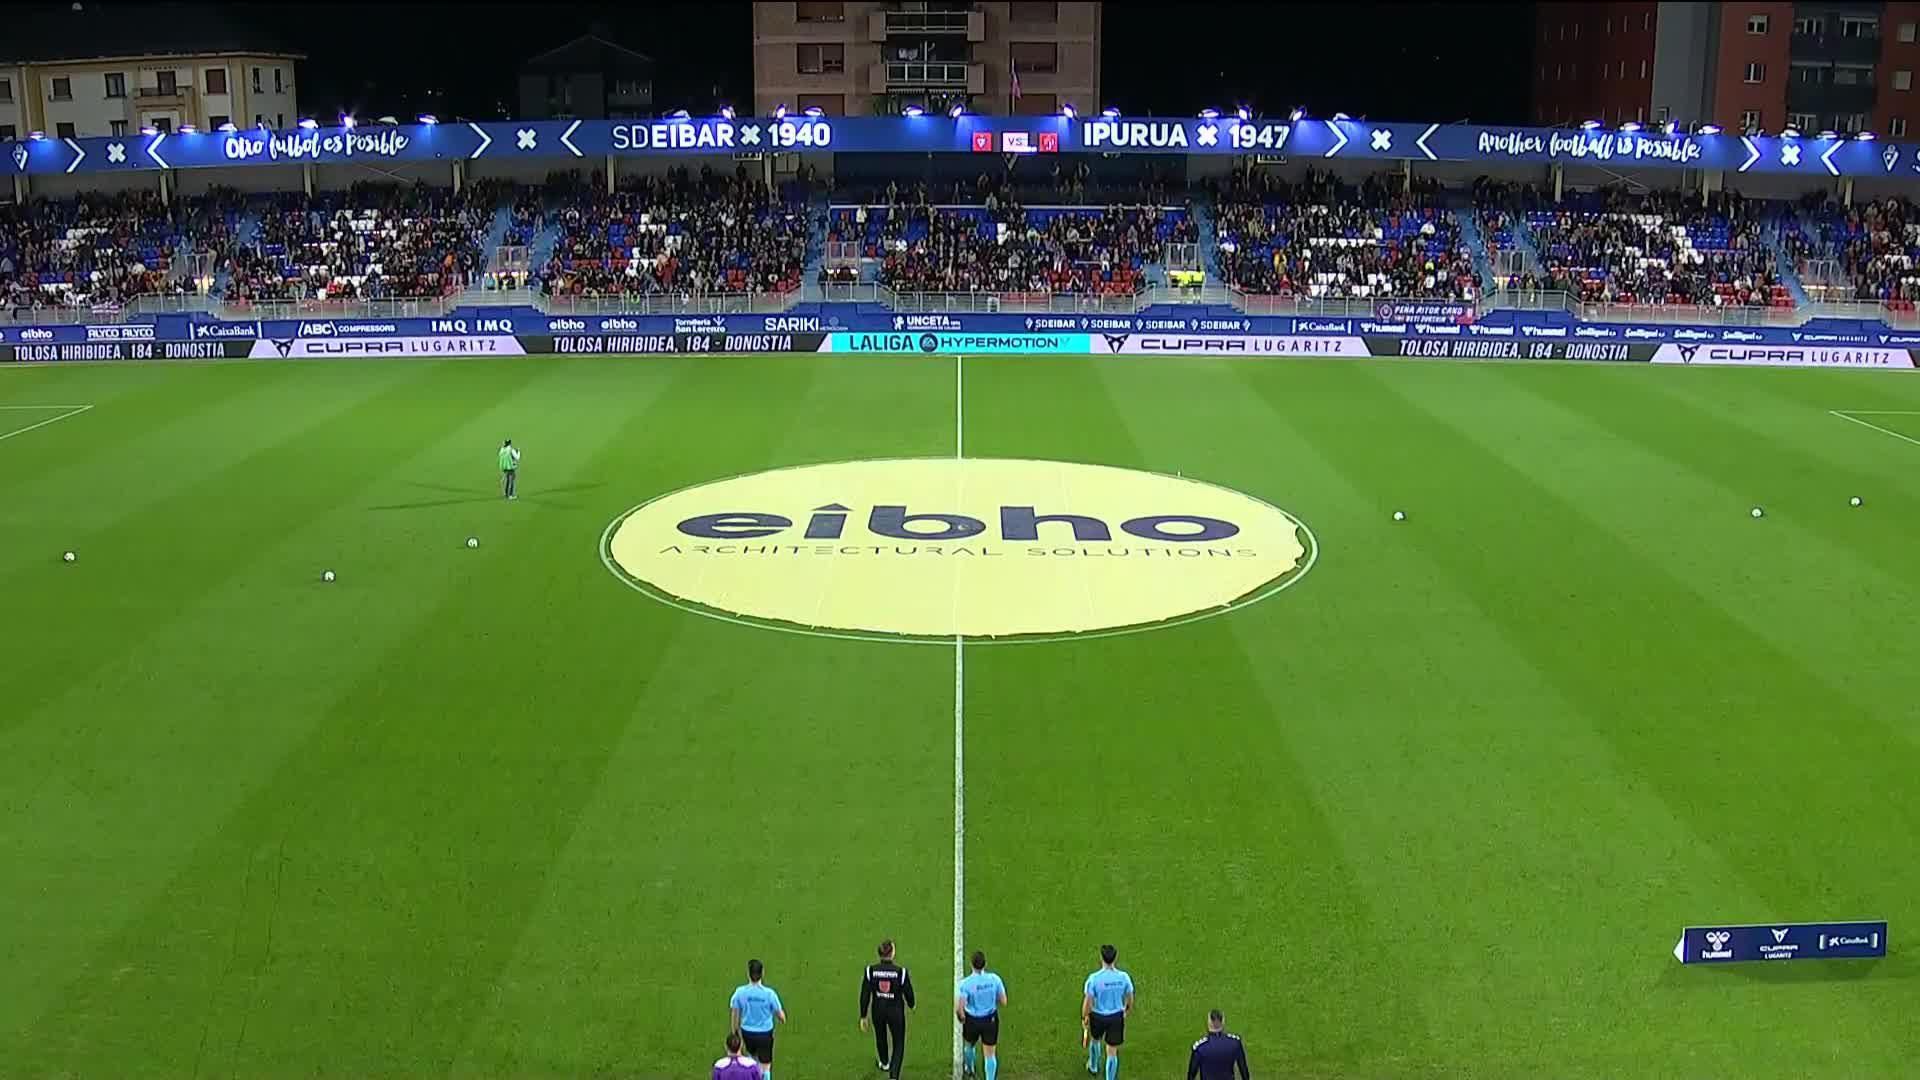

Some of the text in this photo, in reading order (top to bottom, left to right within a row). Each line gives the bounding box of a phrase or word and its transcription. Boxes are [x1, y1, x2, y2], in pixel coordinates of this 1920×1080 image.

[612, 123, 734, 148] SDEIBAR
[768, 123, 830, 146] 1940
[1084, 122, 1188, 147] IPURUA
[1229, 123, 1290, 148] 1947
[323, 136, 342, 151] es
[1478, 132, 1545, 153] Another
[1550, 132, 1613, 159] football
[1617, 137, 1633, 154] is
[431, 320, 468, 333] IMQ
[476, 319, 514, 333] IMQ
[765, 317, 819, 331] SARIKI
[907, 315, 950, 326] UNCETA
[88, 328, 120, 338] ALYCO
[122, 328, 154, 338] ALYCO
[210, 325, 256, 336] CaixaBank
[338, 325, 395, 333] COMPRESSORS
[307, 339, 496, 353] CUPRA LUGARITZ
[553, 337, 602, 352] TOLOSA
[607, 336, 678, 353] HIRIBIDEA,
[686, 336, 710, 351] 184
[725, 335, 792, 351] DONOSTIA
[850, 335, 1058, 351] LALIGA HYPERMOTION
[1141, 338, 1342, 352] CUPRA LUGARITZ
[1400, 340, 1449, 356] TOLOSA
[1452, 341, 1521, 360] HIRIBIDEA,
[1529, 343, 1553, 359] 184
[1565, 344, 1628, 360] DONOSTIA
[15, 346, 57, 360] TOLOSA
[62, 345, 125, 360] HIRIBIDEA,
[131, 344, 152, 359] 184
[166, 343, 224, 358] DONOSTIA
[1710, 349, 1889, 364] CUPRA LUGARITZ
[659, 545, 1257, 558] ARCHITECTURAL SOLUTIONS
